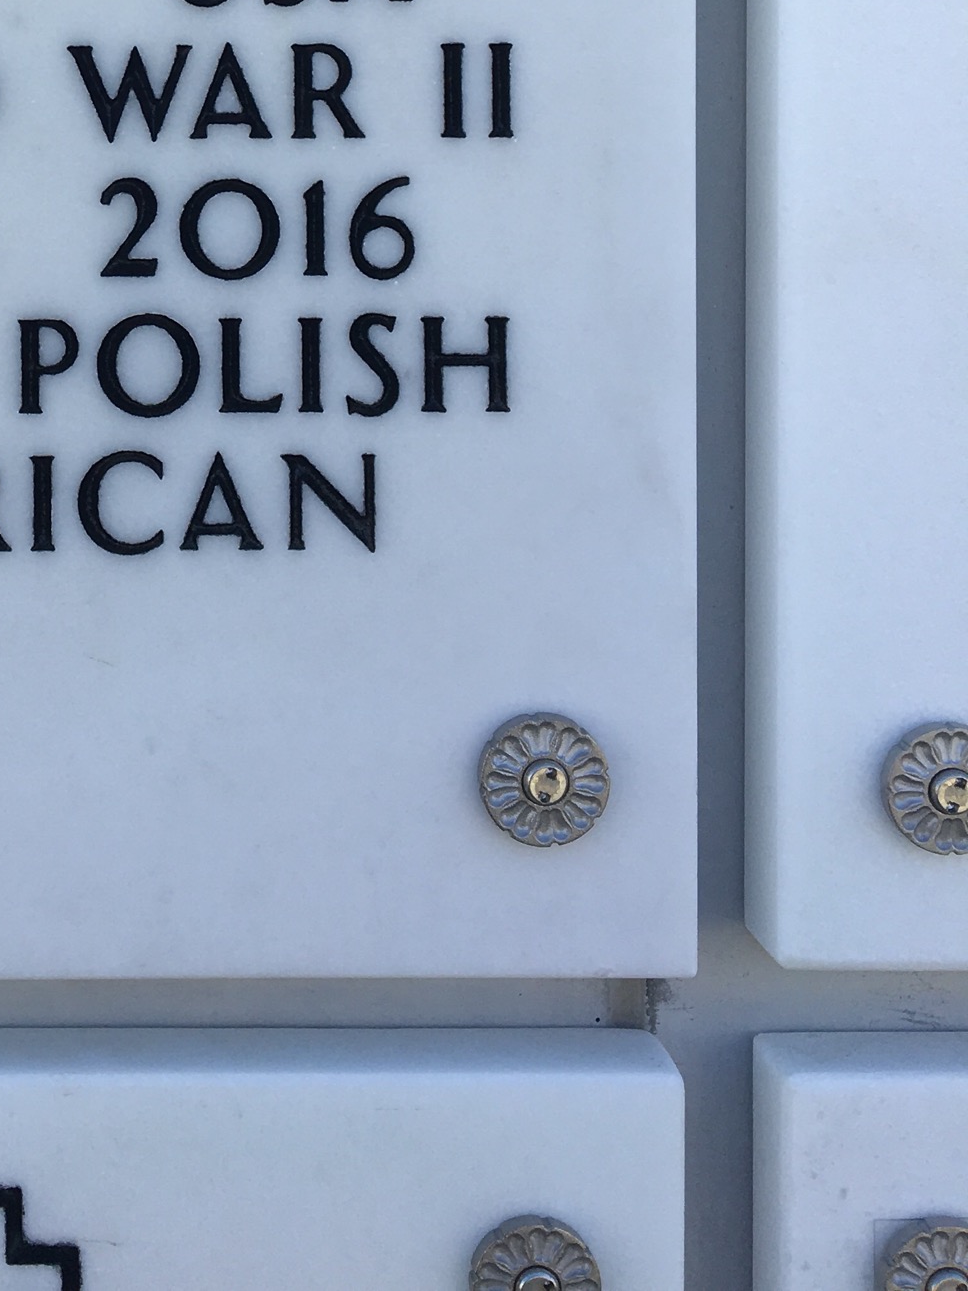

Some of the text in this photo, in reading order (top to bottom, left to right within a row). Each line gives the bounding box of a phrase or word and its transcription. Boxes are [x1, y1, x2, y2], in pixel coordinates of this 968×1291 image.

[66, 41, 367, 144] WAR
[439, 41, 515, 139] II
[99, 175, 416, 282] 2016
[17, 311, 511, 419] POLISH
